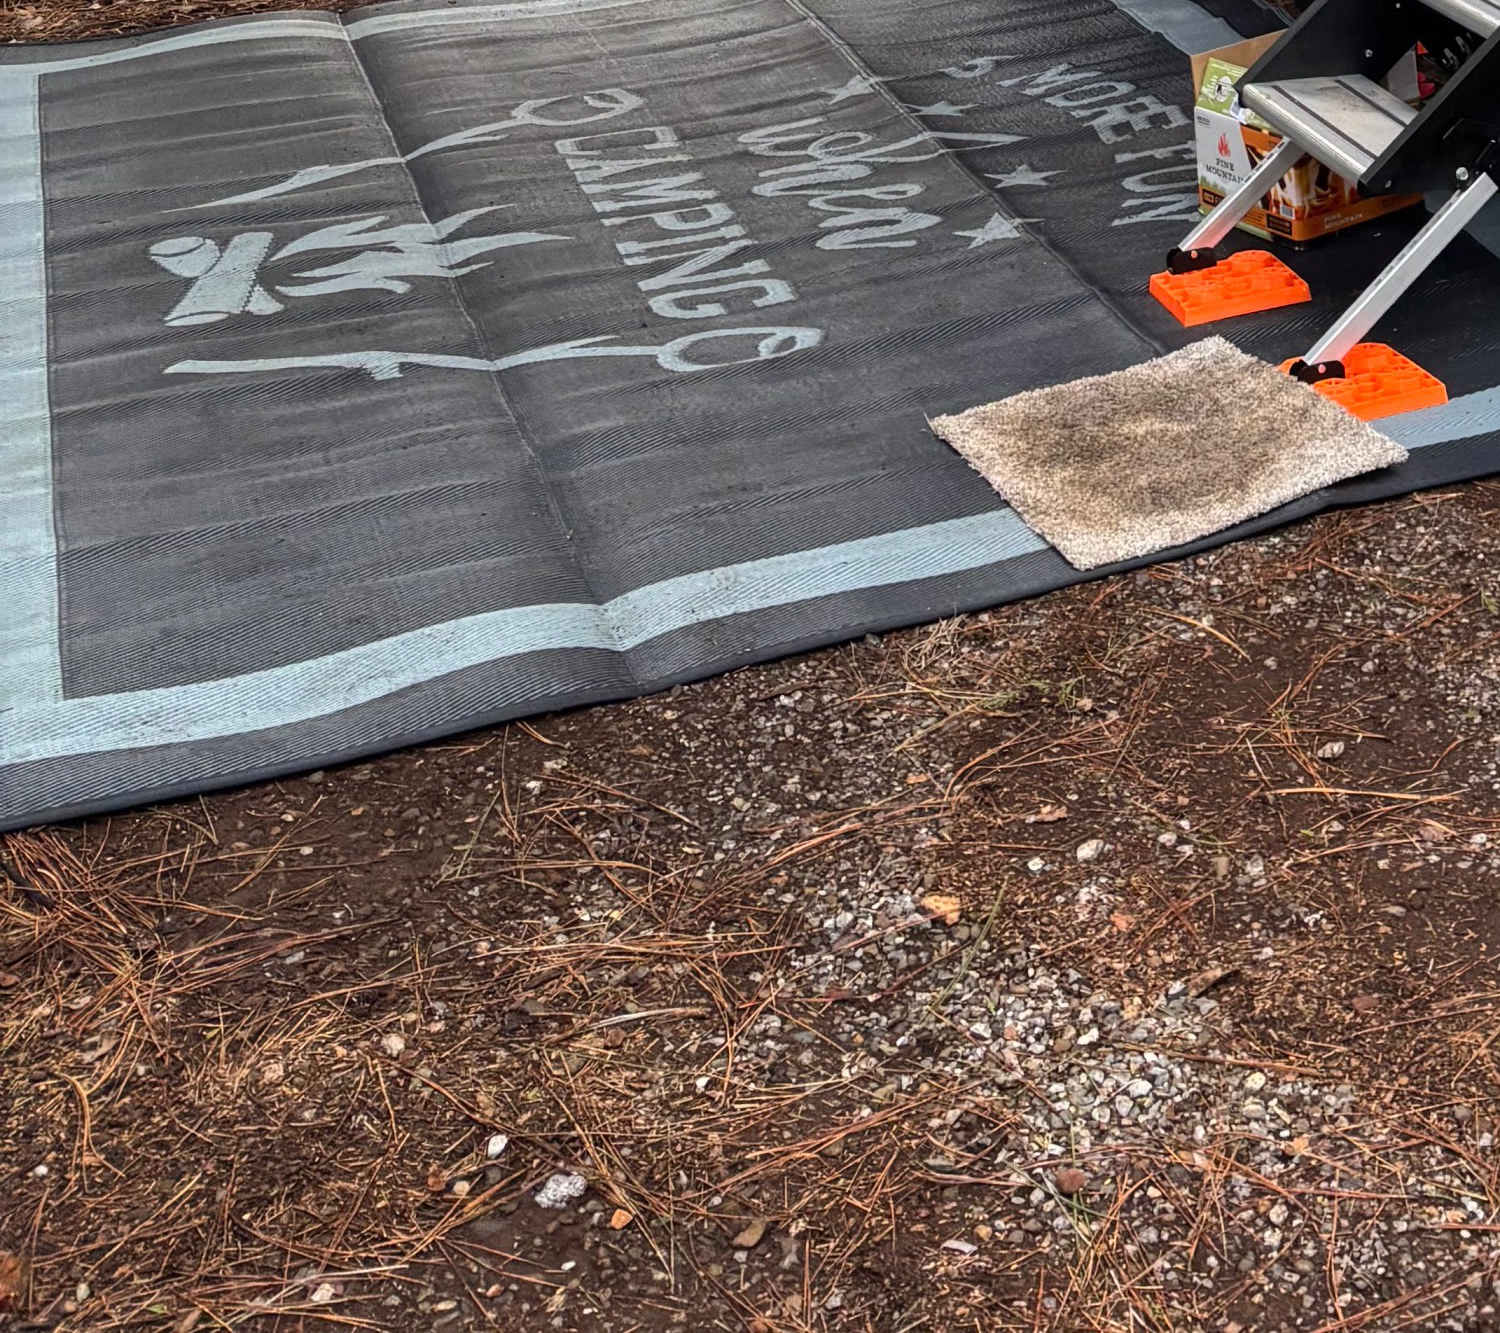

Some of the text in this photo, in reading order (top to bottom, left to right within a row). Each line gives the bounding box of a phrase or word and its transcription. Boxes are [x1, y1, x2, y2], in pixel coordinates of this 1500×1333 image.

[738, 117, 1031, 250] when
[1206, 164, 1244, 185] MOUNTAI
[1215, 158, 1235, 172] PINE
[553, 125, 796, 320] CAMPING
